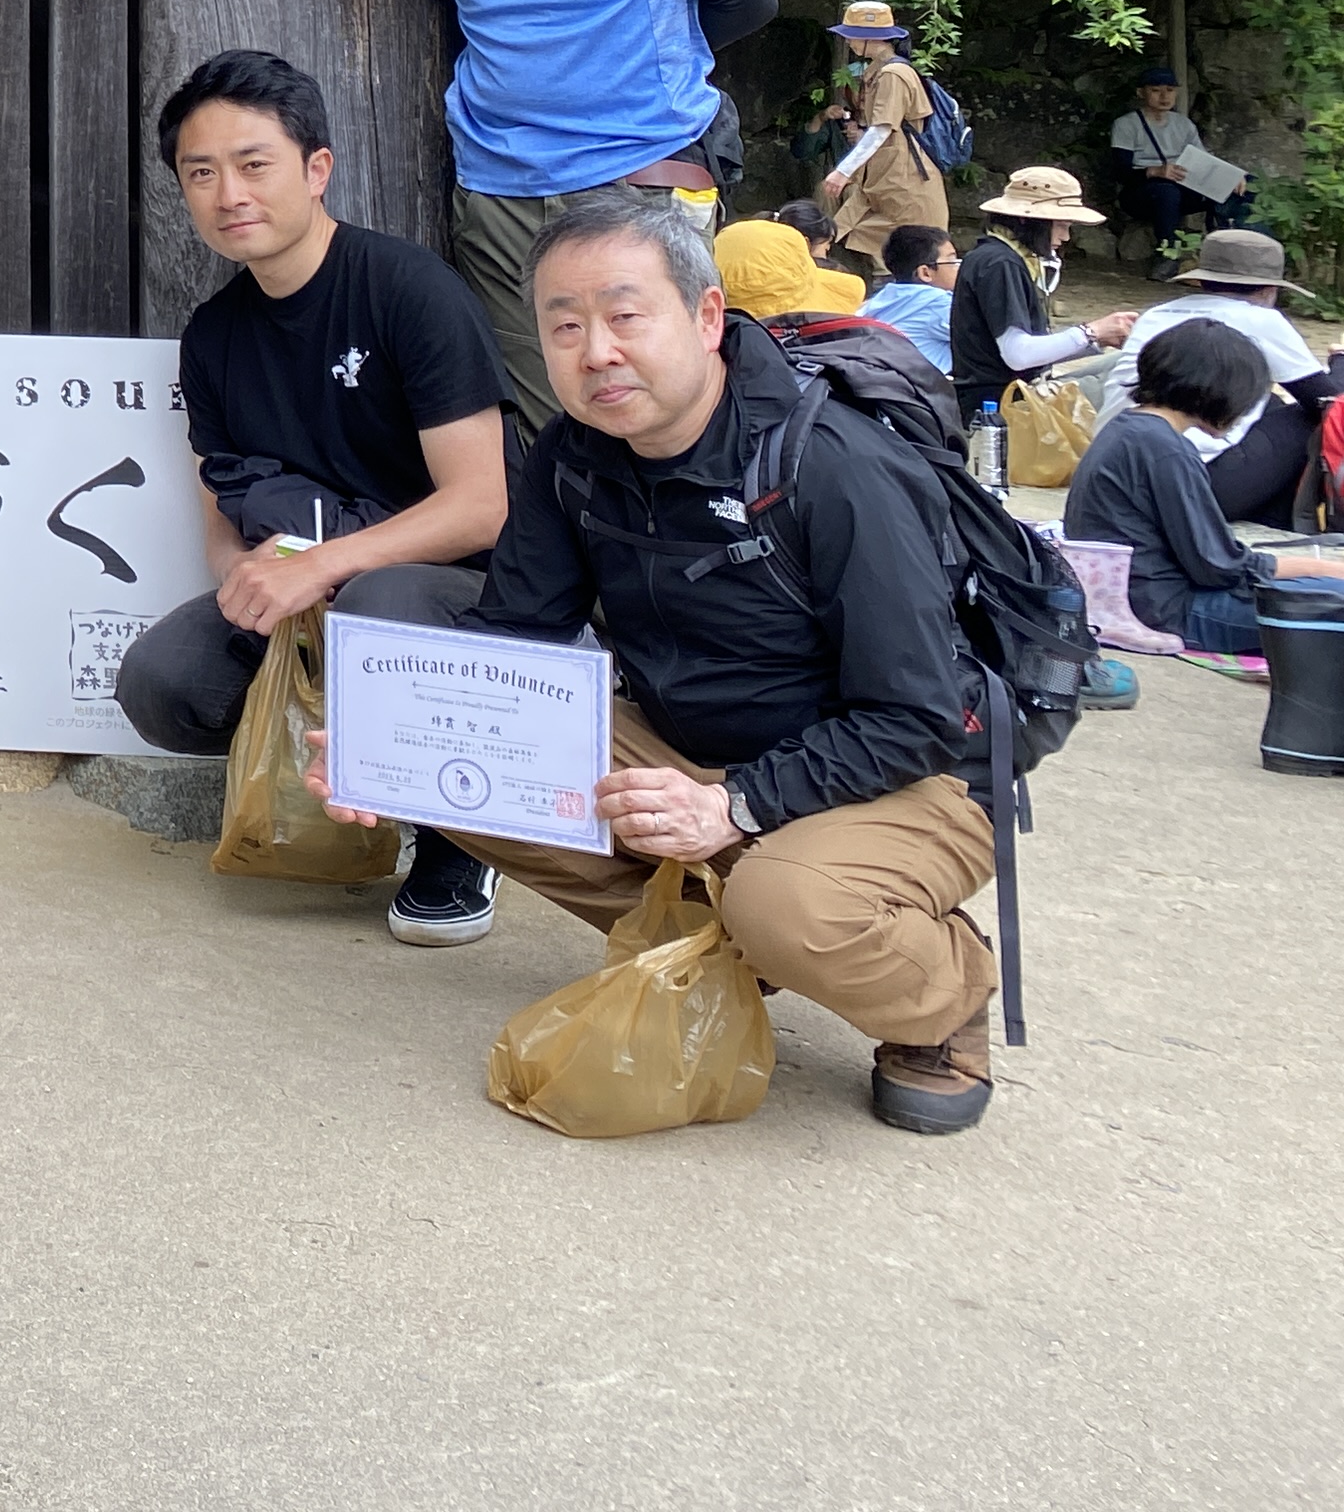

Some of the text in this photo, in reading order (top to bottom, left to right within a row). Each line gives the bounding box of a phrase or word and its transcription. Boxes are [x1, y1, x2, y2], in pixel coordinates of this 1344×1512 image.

[361, 654, 576, 705] Certificate of Volunteer
